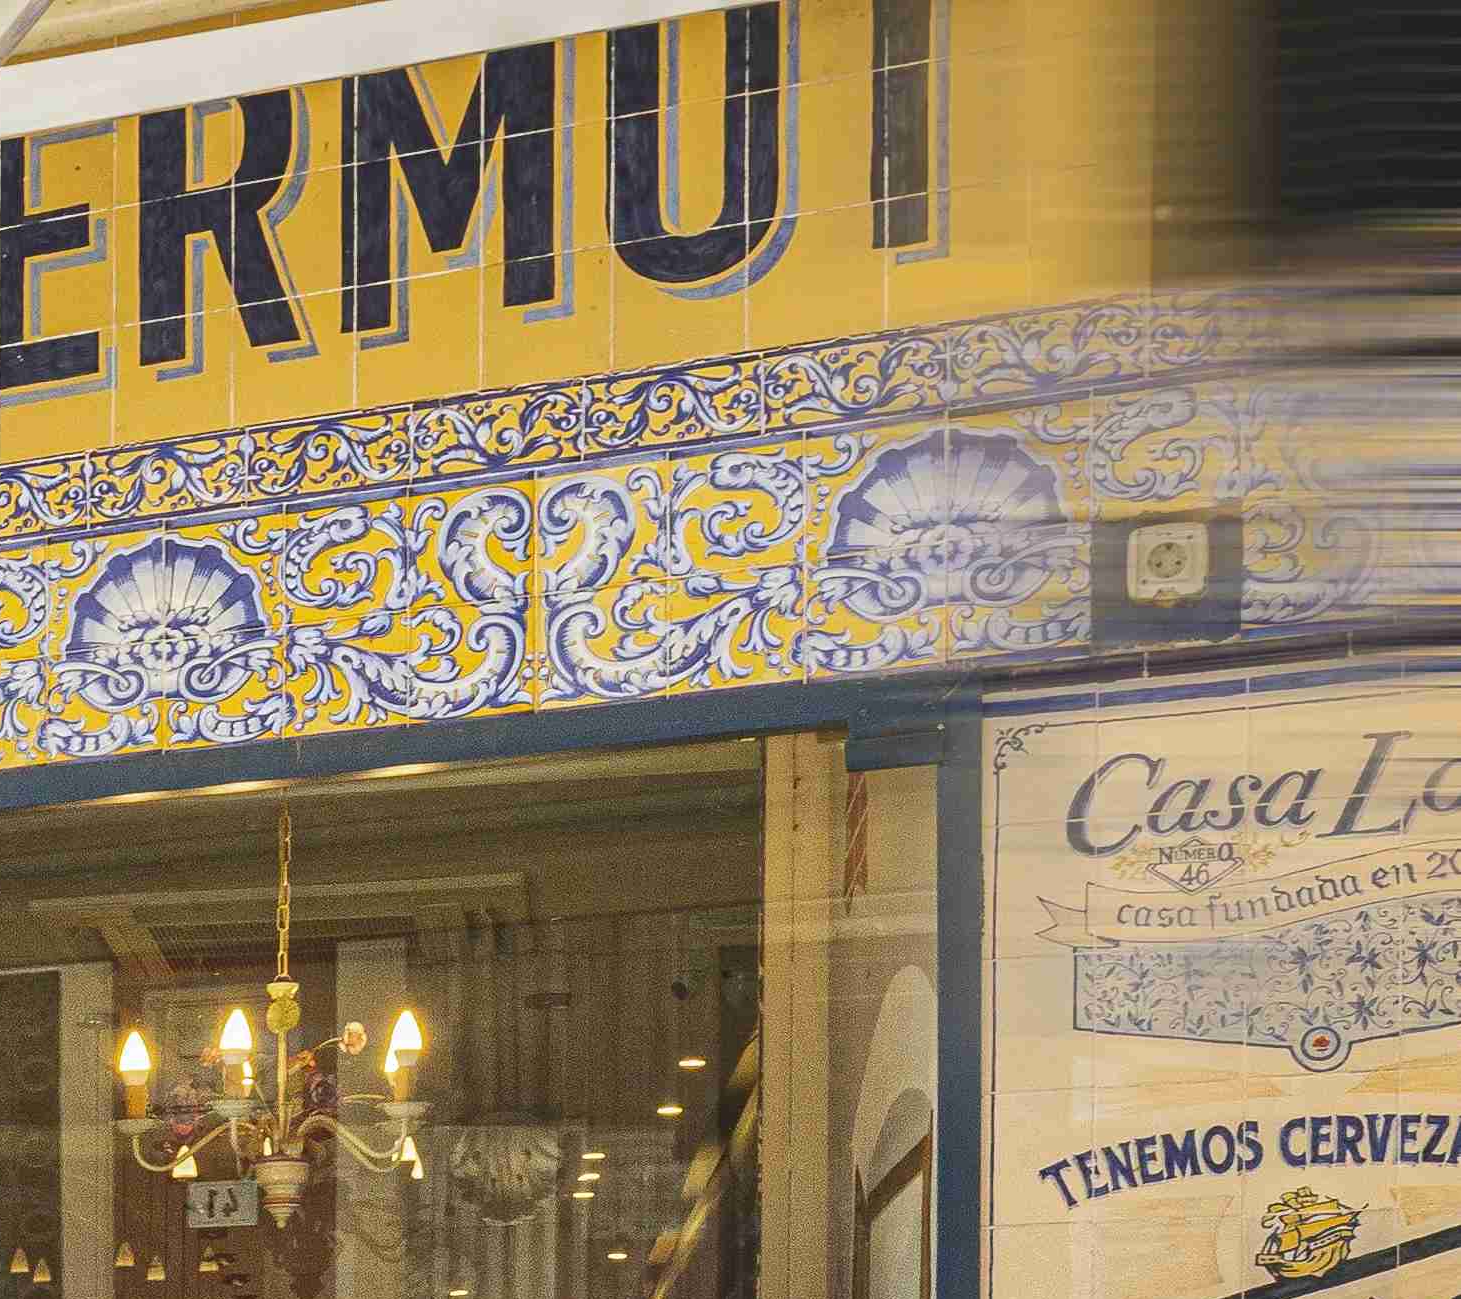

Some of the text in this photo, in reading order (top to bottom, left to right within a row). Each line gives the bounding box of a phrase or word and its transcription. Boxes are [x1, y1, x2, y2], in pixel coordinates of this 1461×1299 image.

[1065, 751, 1325, 857] Casa
[1117, 904, 1195, 930] casa
[1207, 872, 1363, 931] fundada
[1371, 862, 1417, 890] en
[1179, 863, 1210, 886] 46
[1038, 1120, 1265, 1210] TENEMOS
